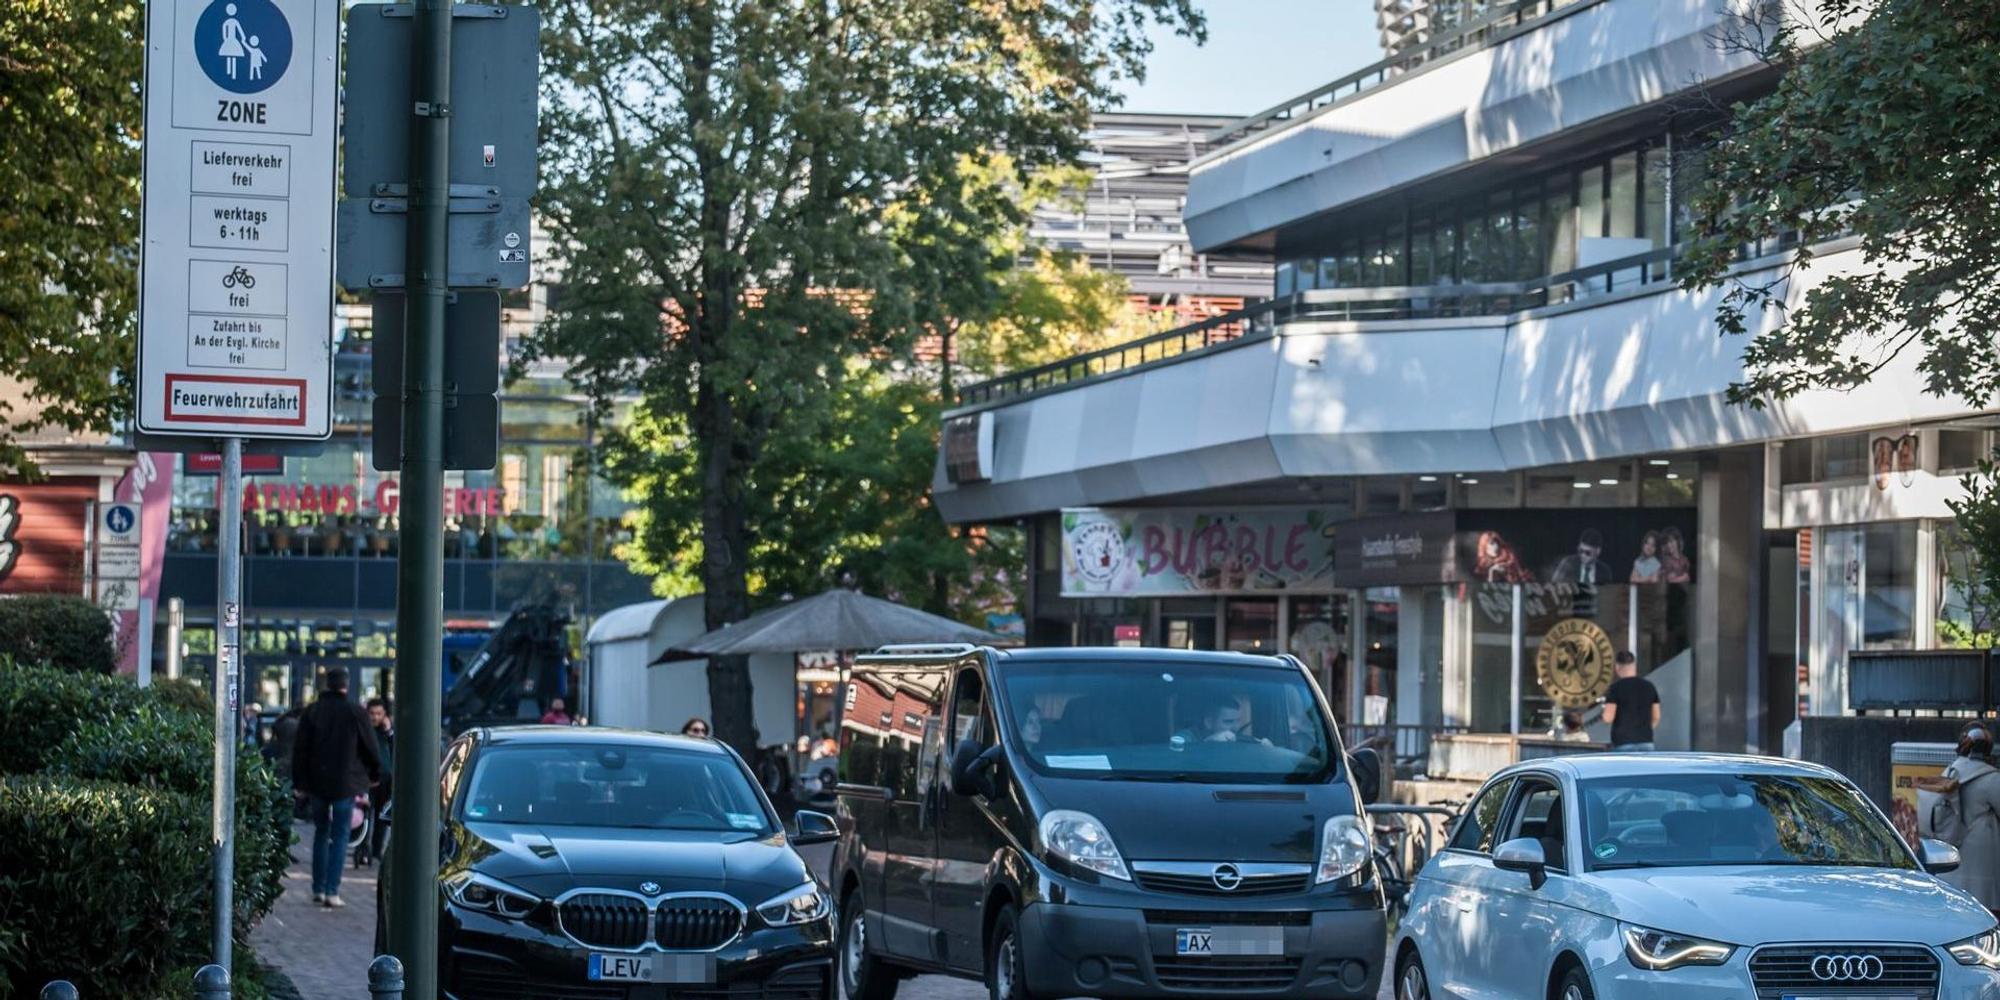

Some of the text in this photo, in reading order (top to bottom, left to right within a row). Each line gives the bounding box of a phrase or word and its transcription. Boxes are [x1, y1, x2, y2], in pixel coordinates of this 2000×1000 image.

[217, 100, 267, 124] ZONE
[204, 150, 283, 168] Lieferverkehr
[232, 172, 253, 186] frei
[214, 206, 268, 225] werktags
[220, 225, 227, 239] 6
[239, 226, 260, 241] 11h
[229, 292, 249, 307] frei
[213, 320, 262, 333] Zufahrt bis
[194, 335, 280, 350] An der Evgl. Kirche
[229, 352, 245, 364] frei
[173, 388, 298, 410] Feuerwehrzufahrt
[1142, 521, 1310, 577] BUBBLE
[1188, 935, 1211, 951] AX
[602, 958, 641, 977] LEV
